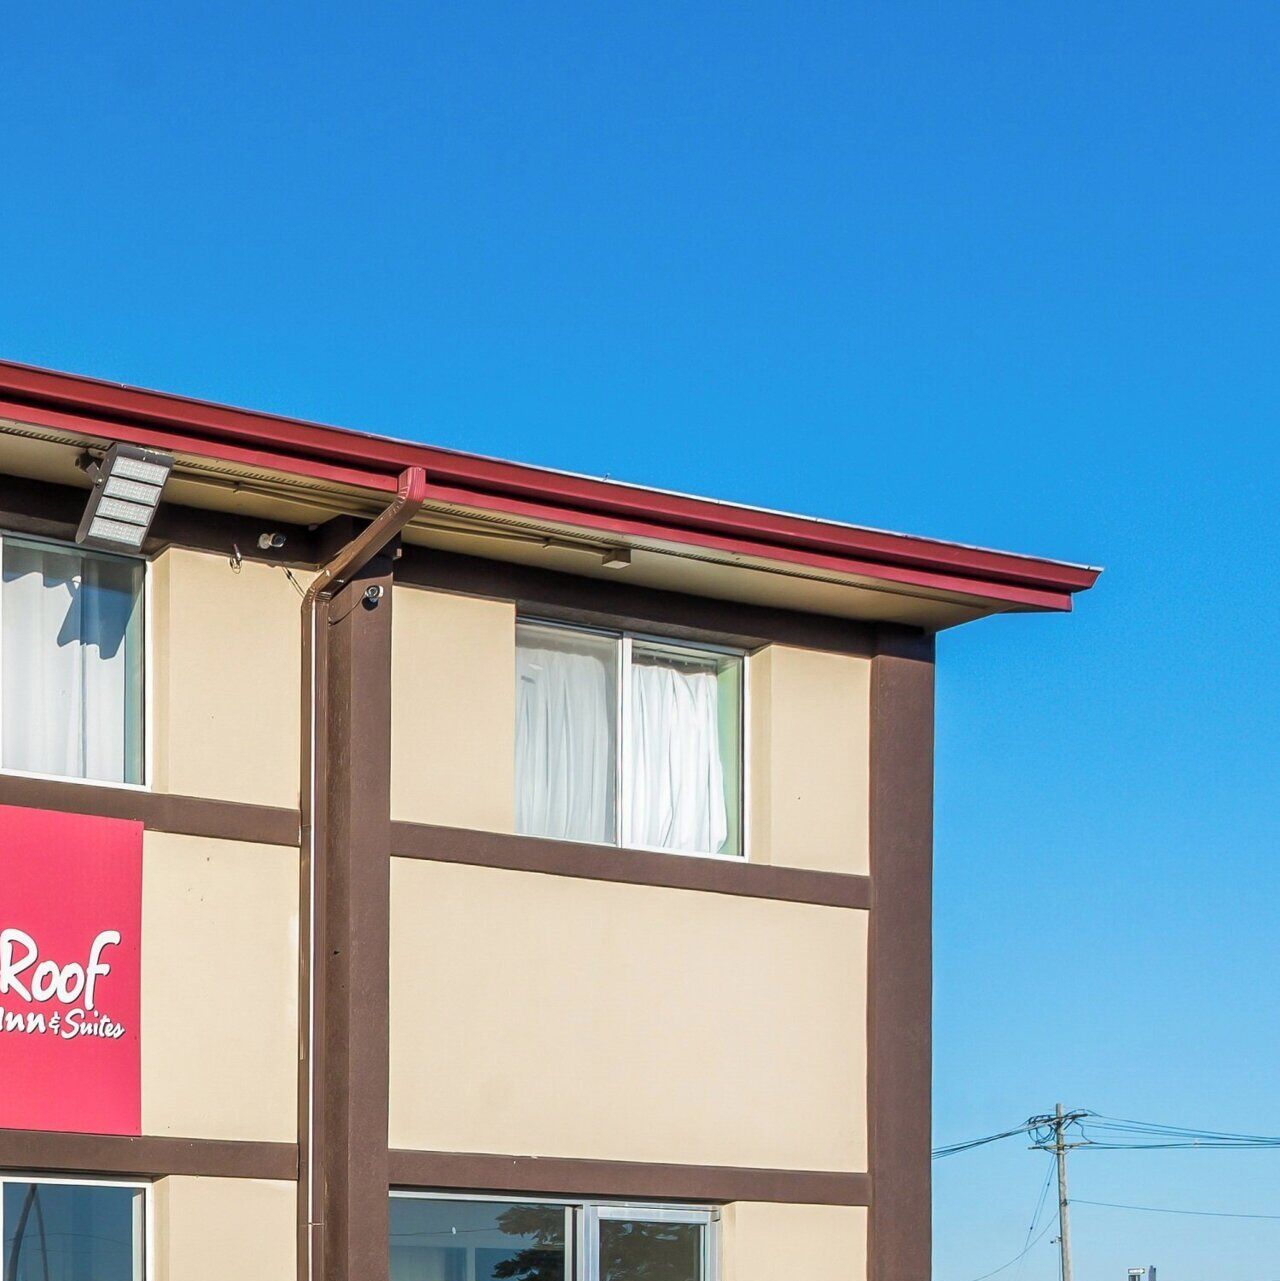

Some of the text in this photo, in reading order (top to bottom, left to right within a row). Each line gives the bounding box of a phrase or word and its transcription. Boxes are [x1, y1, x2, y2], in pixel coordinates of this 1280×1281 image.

[0, 928, 121, 1010] Roof
[48, 1012, 61, 1034] &
[61, 1008, 125, 1039] Suites
